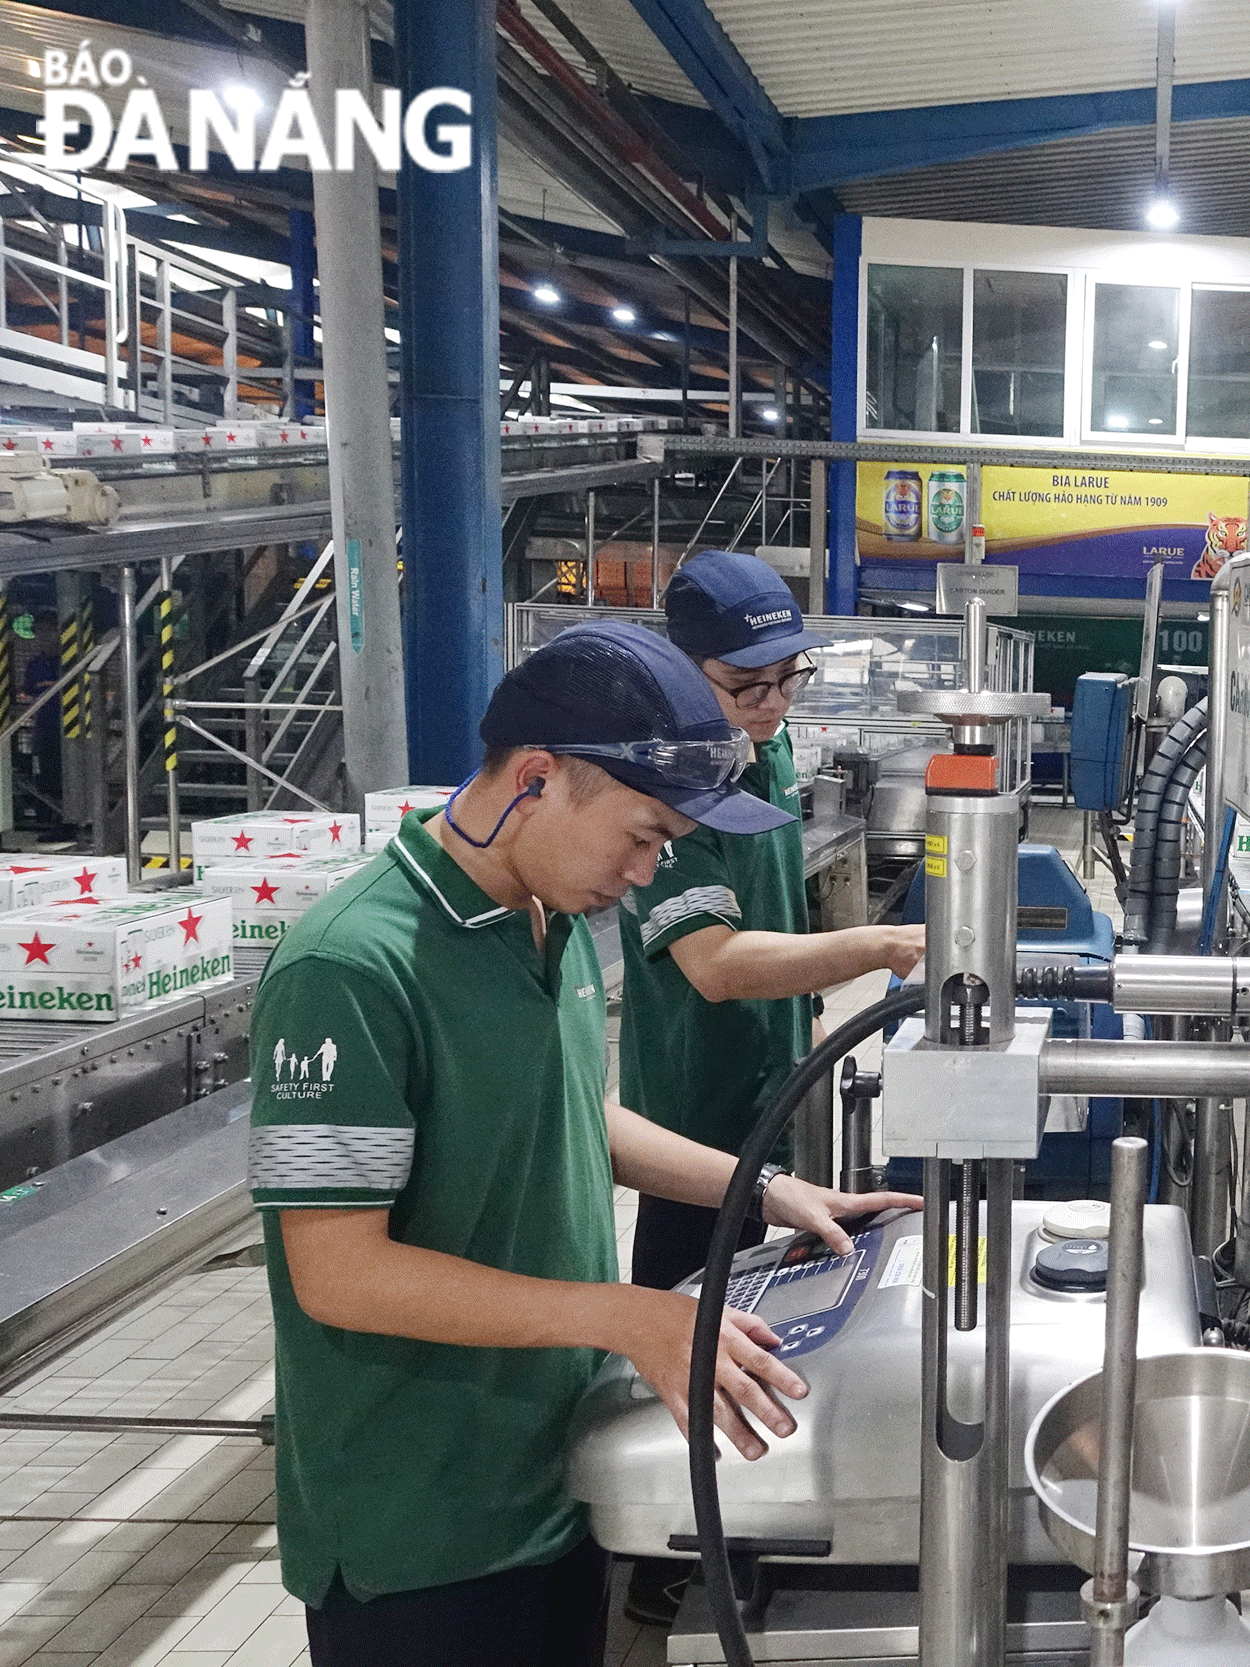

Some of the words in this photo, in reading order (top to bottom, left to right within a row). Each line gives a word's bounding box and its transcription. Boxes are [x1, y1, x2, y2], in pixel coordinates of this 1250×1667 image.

[1052, 474, 1071, 487] BIA
[1074, 475, 1110, 489] LARUE
[992, 488, 1017, 501] CHẤT
[1018, 492, 1051, 505] LƯỢNG
[1053, 490, 1074, 504] HẢO
[1075, 494, 1103, 507] HẠNG
[1145, 496, 1168, 507] 1909
[1142, 546, 1185, 556] LARUE
[350, 567, 359, 588] Rain
[351, 589, 361, 617] Water
[749, 609, 793, 626] HEINEKEN
[1158, 630, 1203, 652] 100
[148, 953, 231, 1000] Heineken
[0, 985, 114, 1011] ineken
[270, 1082, 300, 1092] SAFETY
[302, 1082, 335, 1092] FIRST
[276, 1091, 322, 1100] CULTURE
